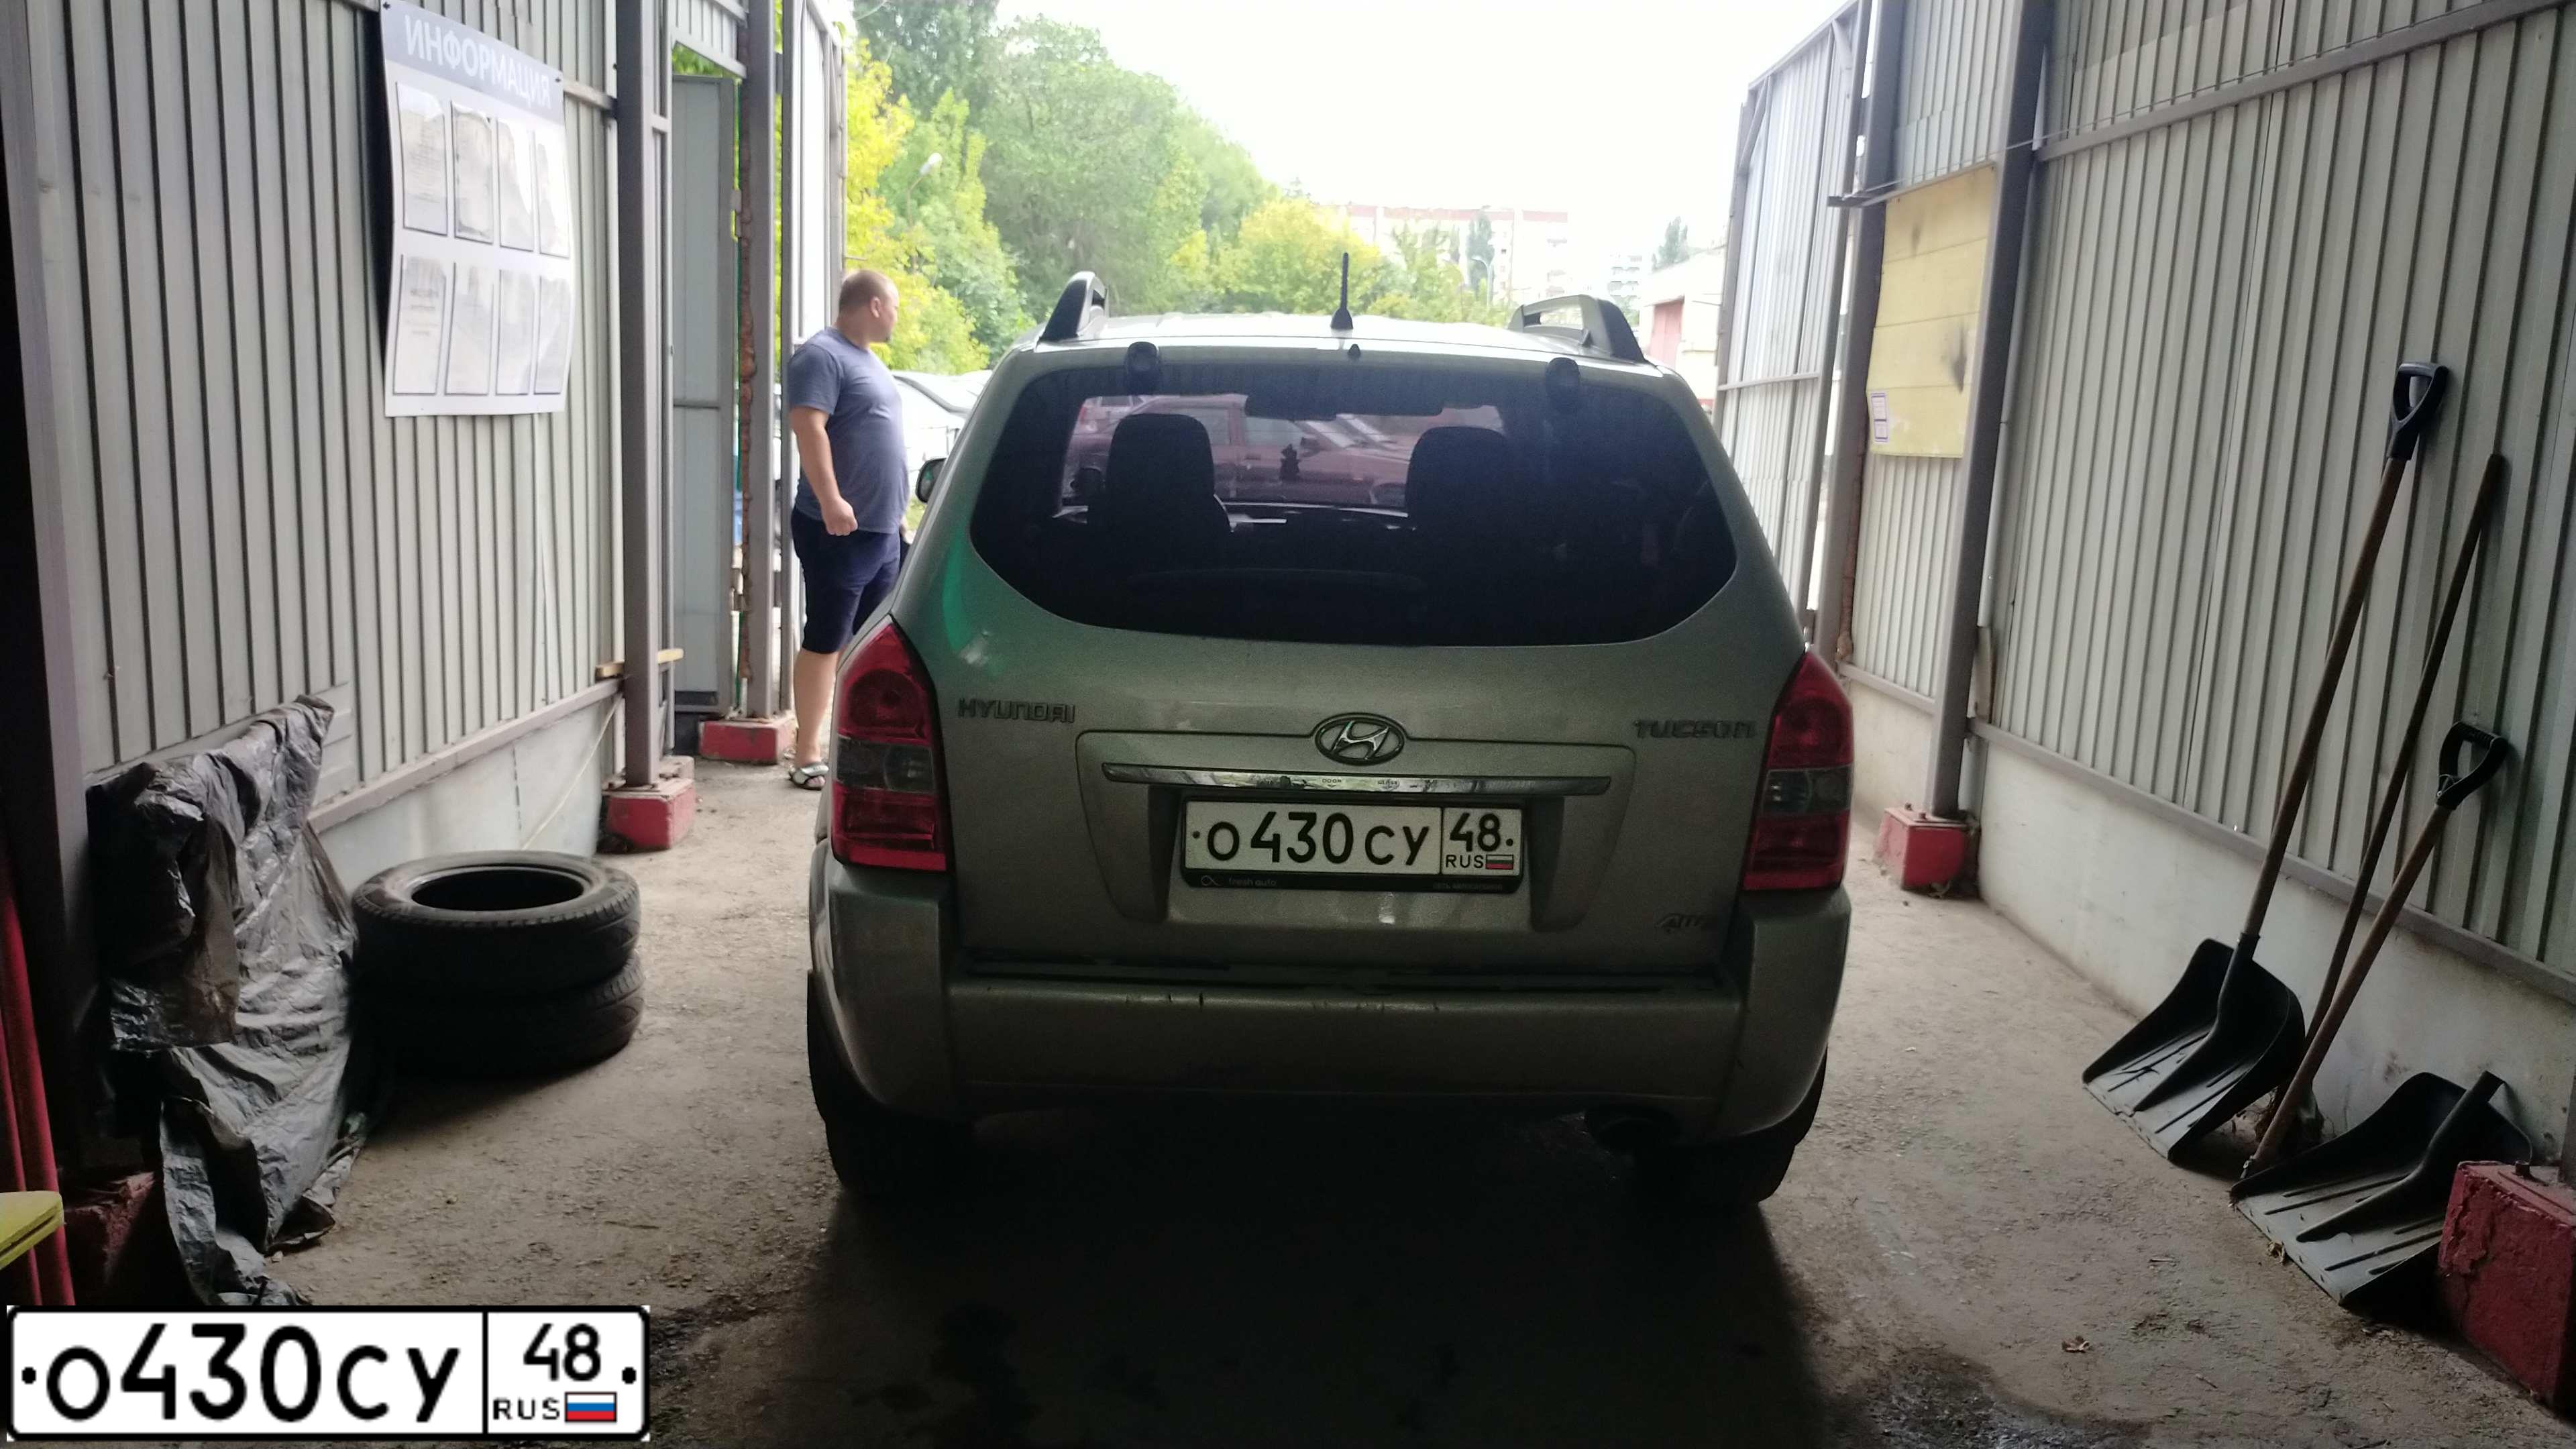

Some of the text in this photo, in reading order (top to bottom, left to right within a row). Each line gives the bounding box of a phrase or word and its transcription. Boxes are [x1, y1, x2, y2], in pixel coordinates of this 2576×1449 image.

[405, 14, 552, 109] ИНФОРМАЦИЯ
[959, 698, 1075, 723] HYUNDAI
[1633, 720, 1754, 739] TUCSON
[1208, 811, 1501, 865] О430СУ 48
[1445, 854, 1485, 869] RUS
